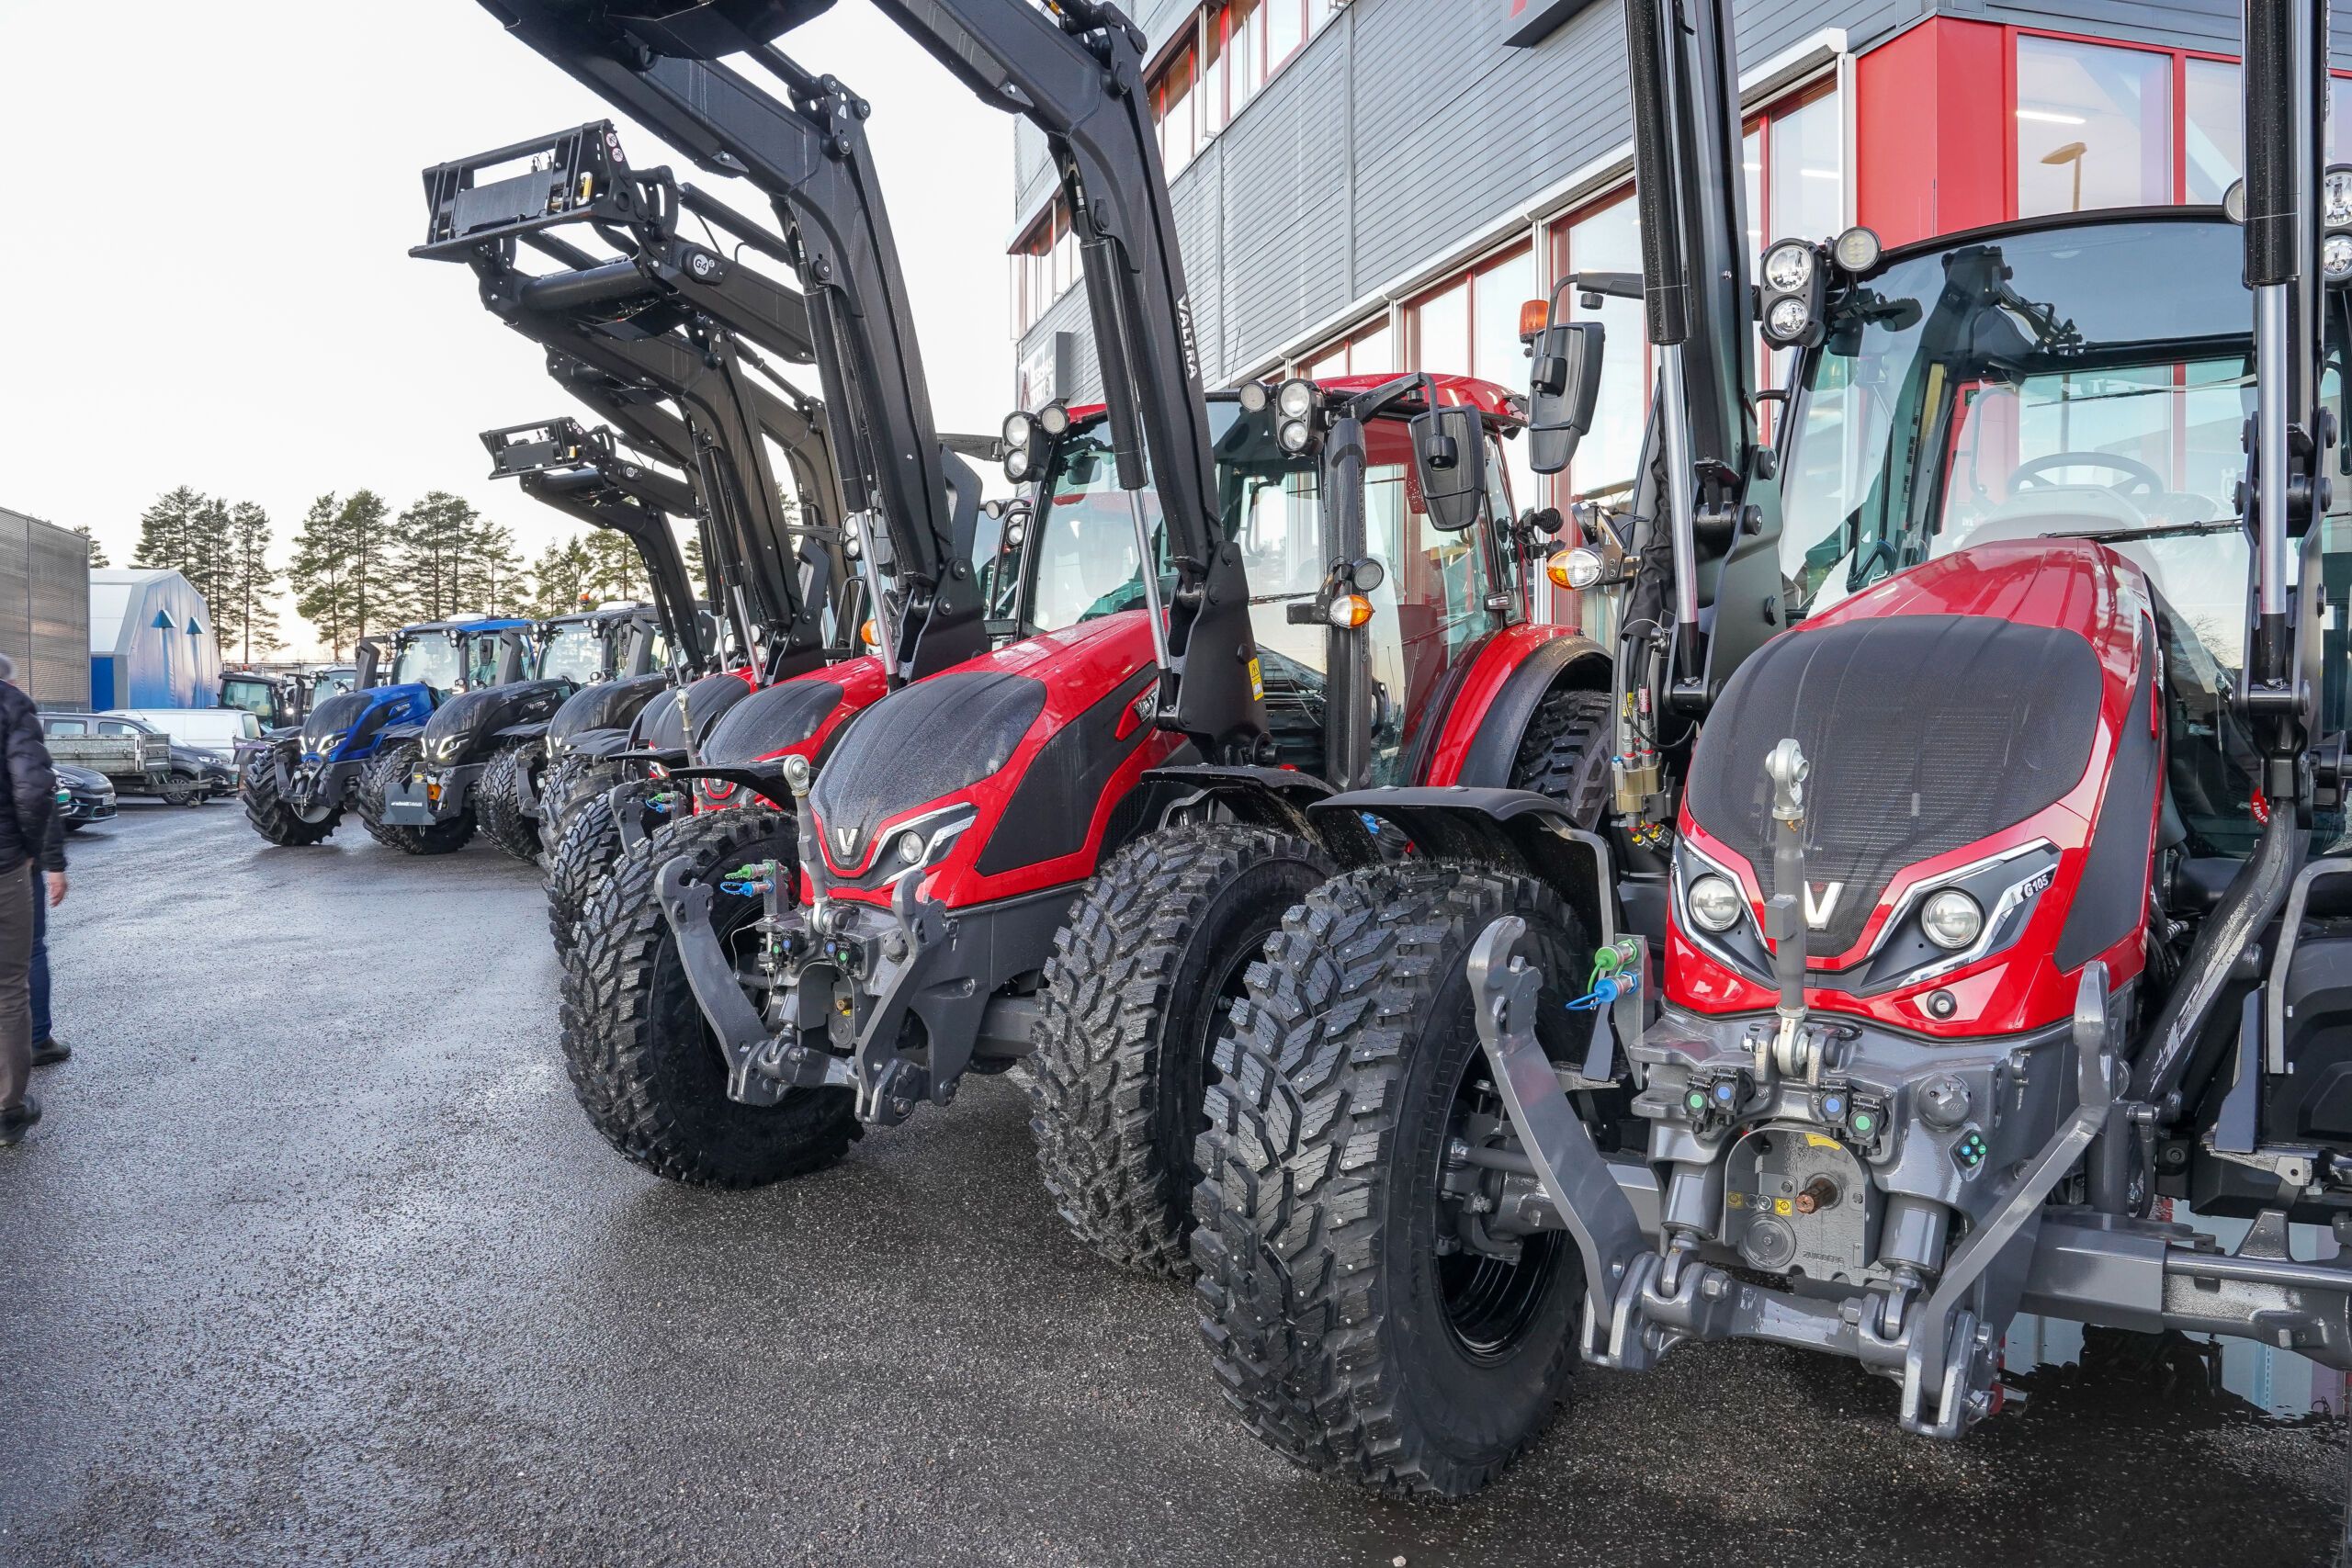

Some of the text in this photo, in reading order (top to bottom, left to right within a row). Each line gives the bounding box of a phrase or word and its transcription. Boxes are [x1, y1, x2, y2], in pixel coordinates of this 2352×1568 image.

[695, 258, 707, 272] G4
[1177, 292, 1198, 379] VALTRA
[2024, 874, 2049, 897] G105
